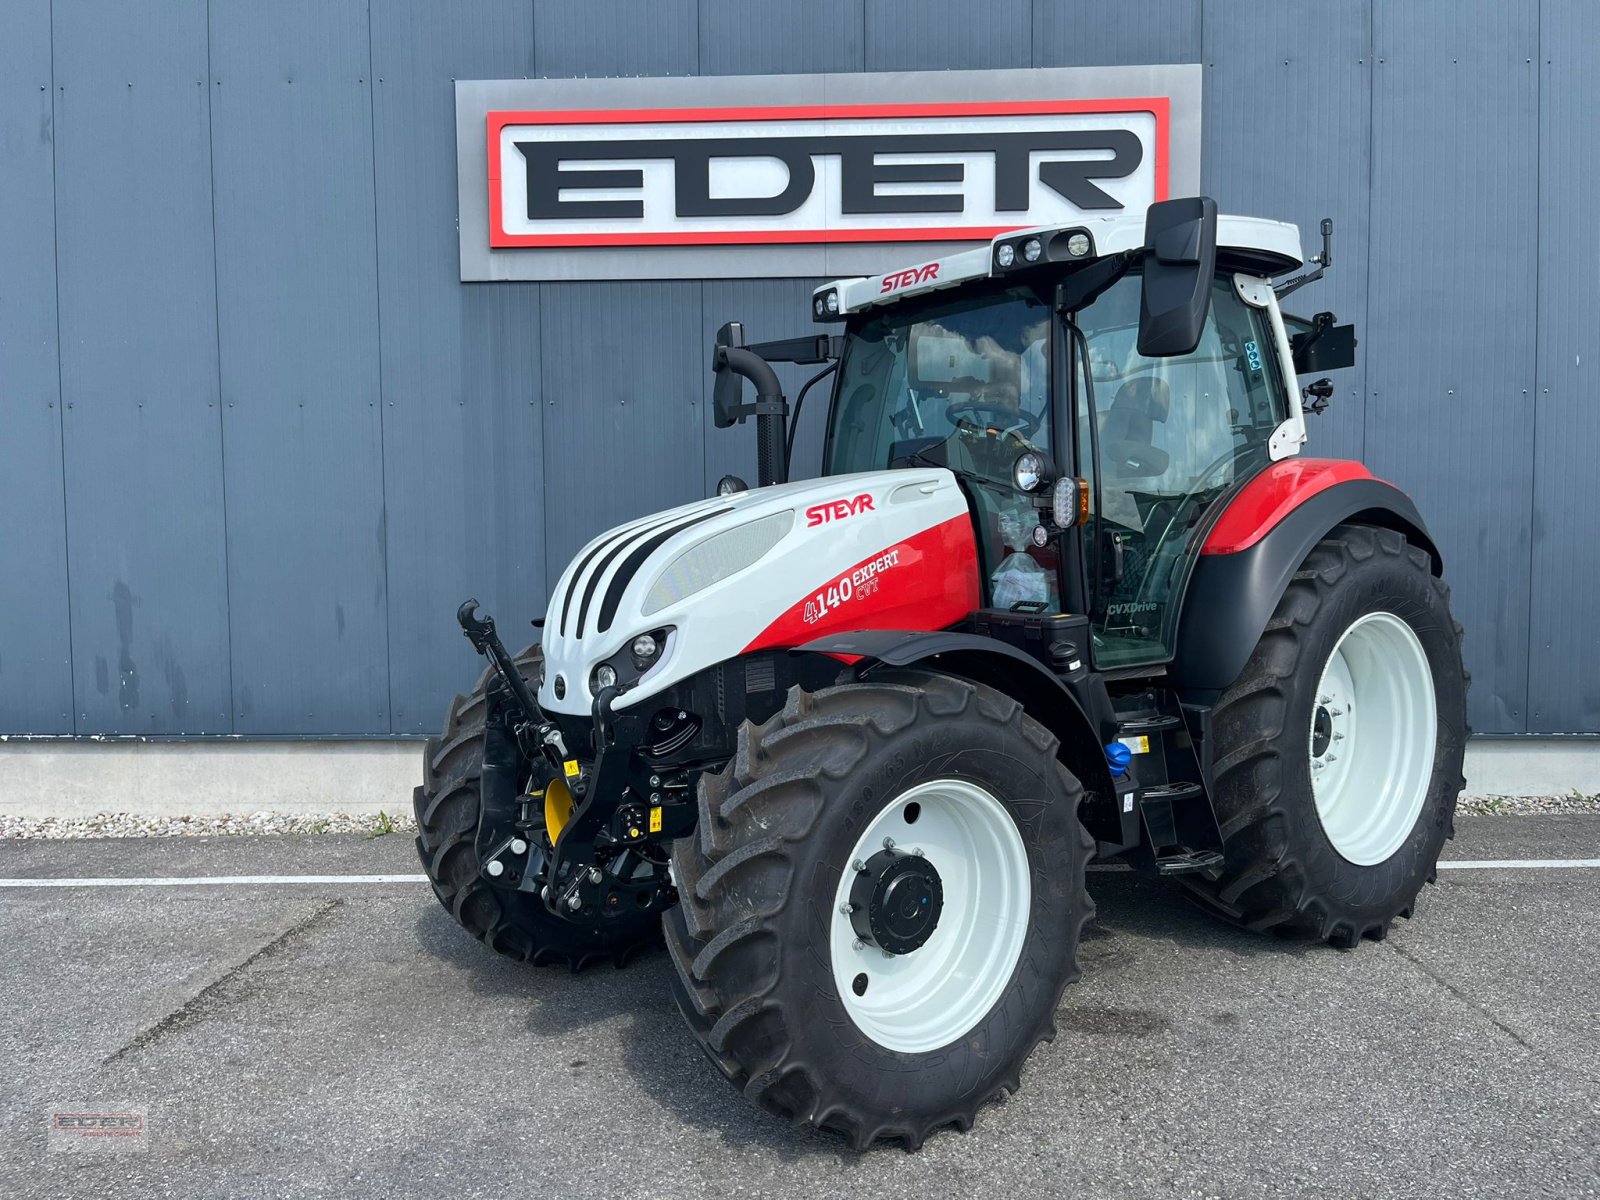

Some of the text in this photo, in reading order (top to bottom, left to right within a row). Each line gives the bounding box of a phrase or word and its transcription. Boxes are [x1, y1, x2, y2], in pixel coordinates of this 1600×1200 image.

[513, 129, 1143, 219] EDER
[880, 263, 940, 294] STEYR
[805, 493, 876, 528] STEYR
[803, 549, 899, 625] 4140 EXPERT
[855, 577, 879, 601] CVT
[1108, 601, 1158, 616] CVXDrive
